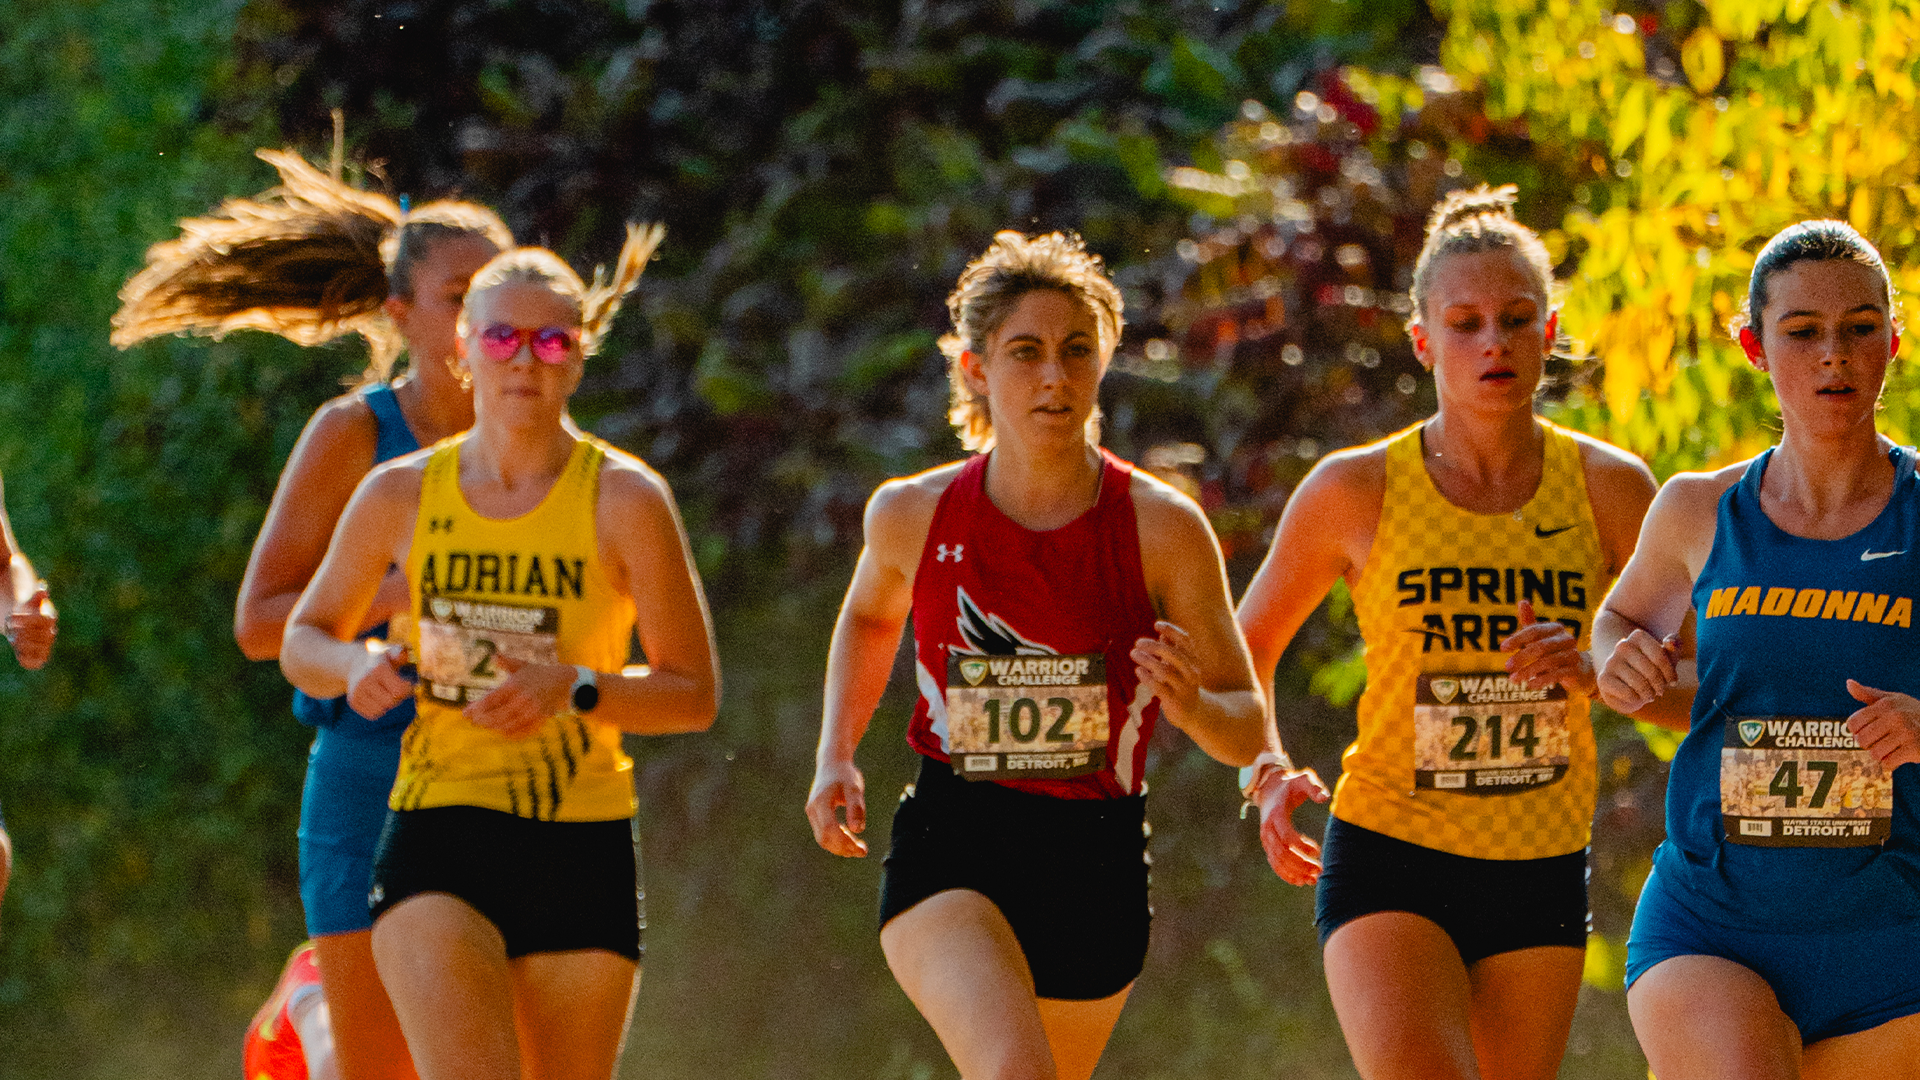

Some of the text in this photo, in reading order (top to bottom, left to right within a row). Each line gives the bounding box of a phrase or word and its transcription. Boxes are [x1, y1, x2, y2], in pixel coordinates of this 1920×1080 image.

[421, 553, 588, 600] ADRIAN
[1398, 567, 1586, 611] SPRING
[1706, 586, 1913, 628] MADONNA
[1420, 614, 1581, 652] ARB
[470, 638, 498, 677] 2
[989, 659, 1089, 676] WARRIOR
[998, 675, 1080, 686] CHALLENGE
[1468, 690, 1548, 703] CHALLENGE
[983, 697, 1074, 744] 102
[1449, 714, 1540, 761] 214
[1767, 720, 1854, 737] WARRIO
[1006, 759, 1071, 770] DETROIT,
[1476, 773, 1536, 787] DETROIT,
[1769, 761, 1838, 809] 47
[1783, 825, 1870, 837] DETROIT, MI
